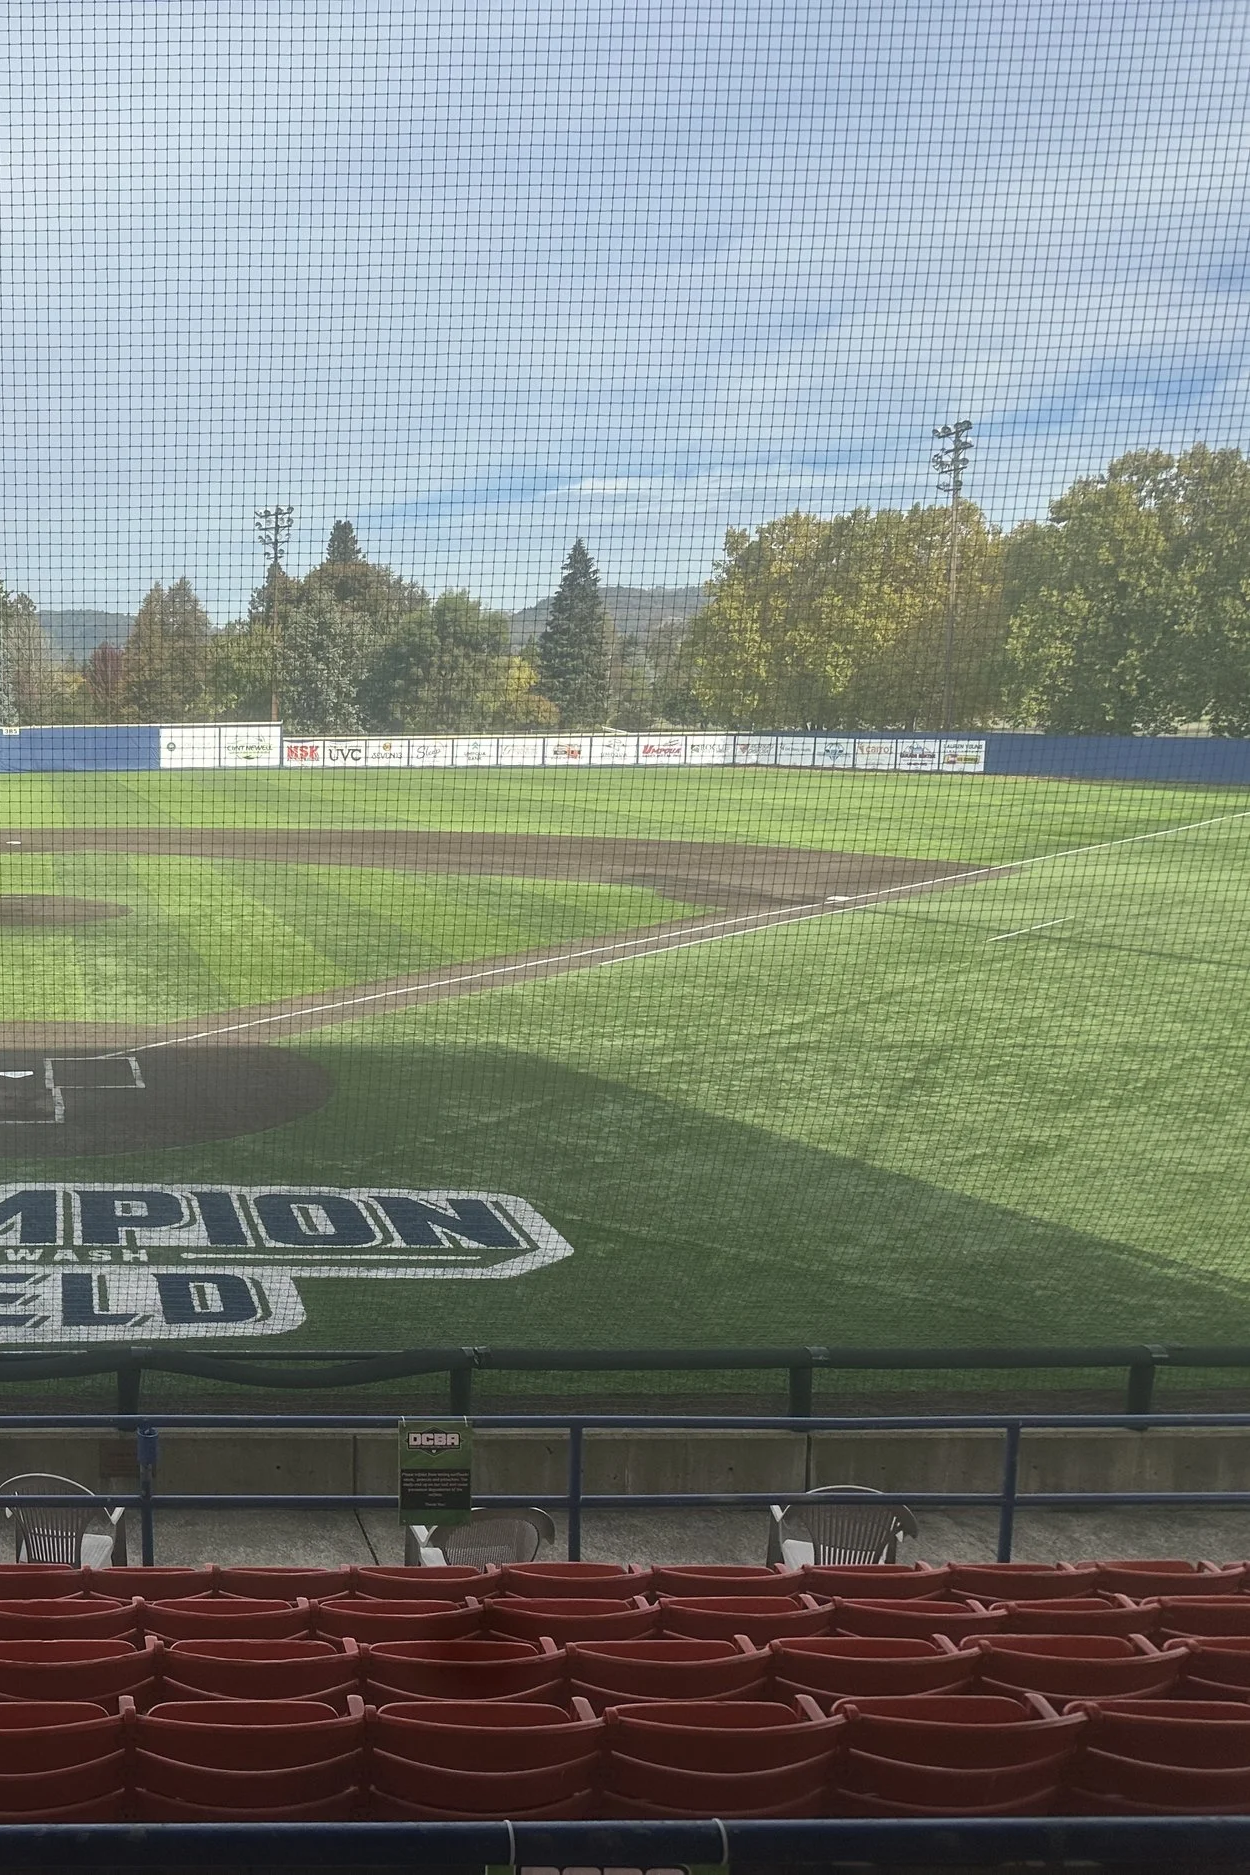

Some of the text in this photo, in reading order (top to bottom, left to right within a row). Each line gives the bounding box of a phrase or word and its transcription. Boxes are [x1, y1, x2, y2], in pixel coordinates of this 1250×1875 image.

[329, 749, 362, 762] UVC
[5, 1248, 150, 1263] WASH
[408, 1433, 460, 1446] DCBA
